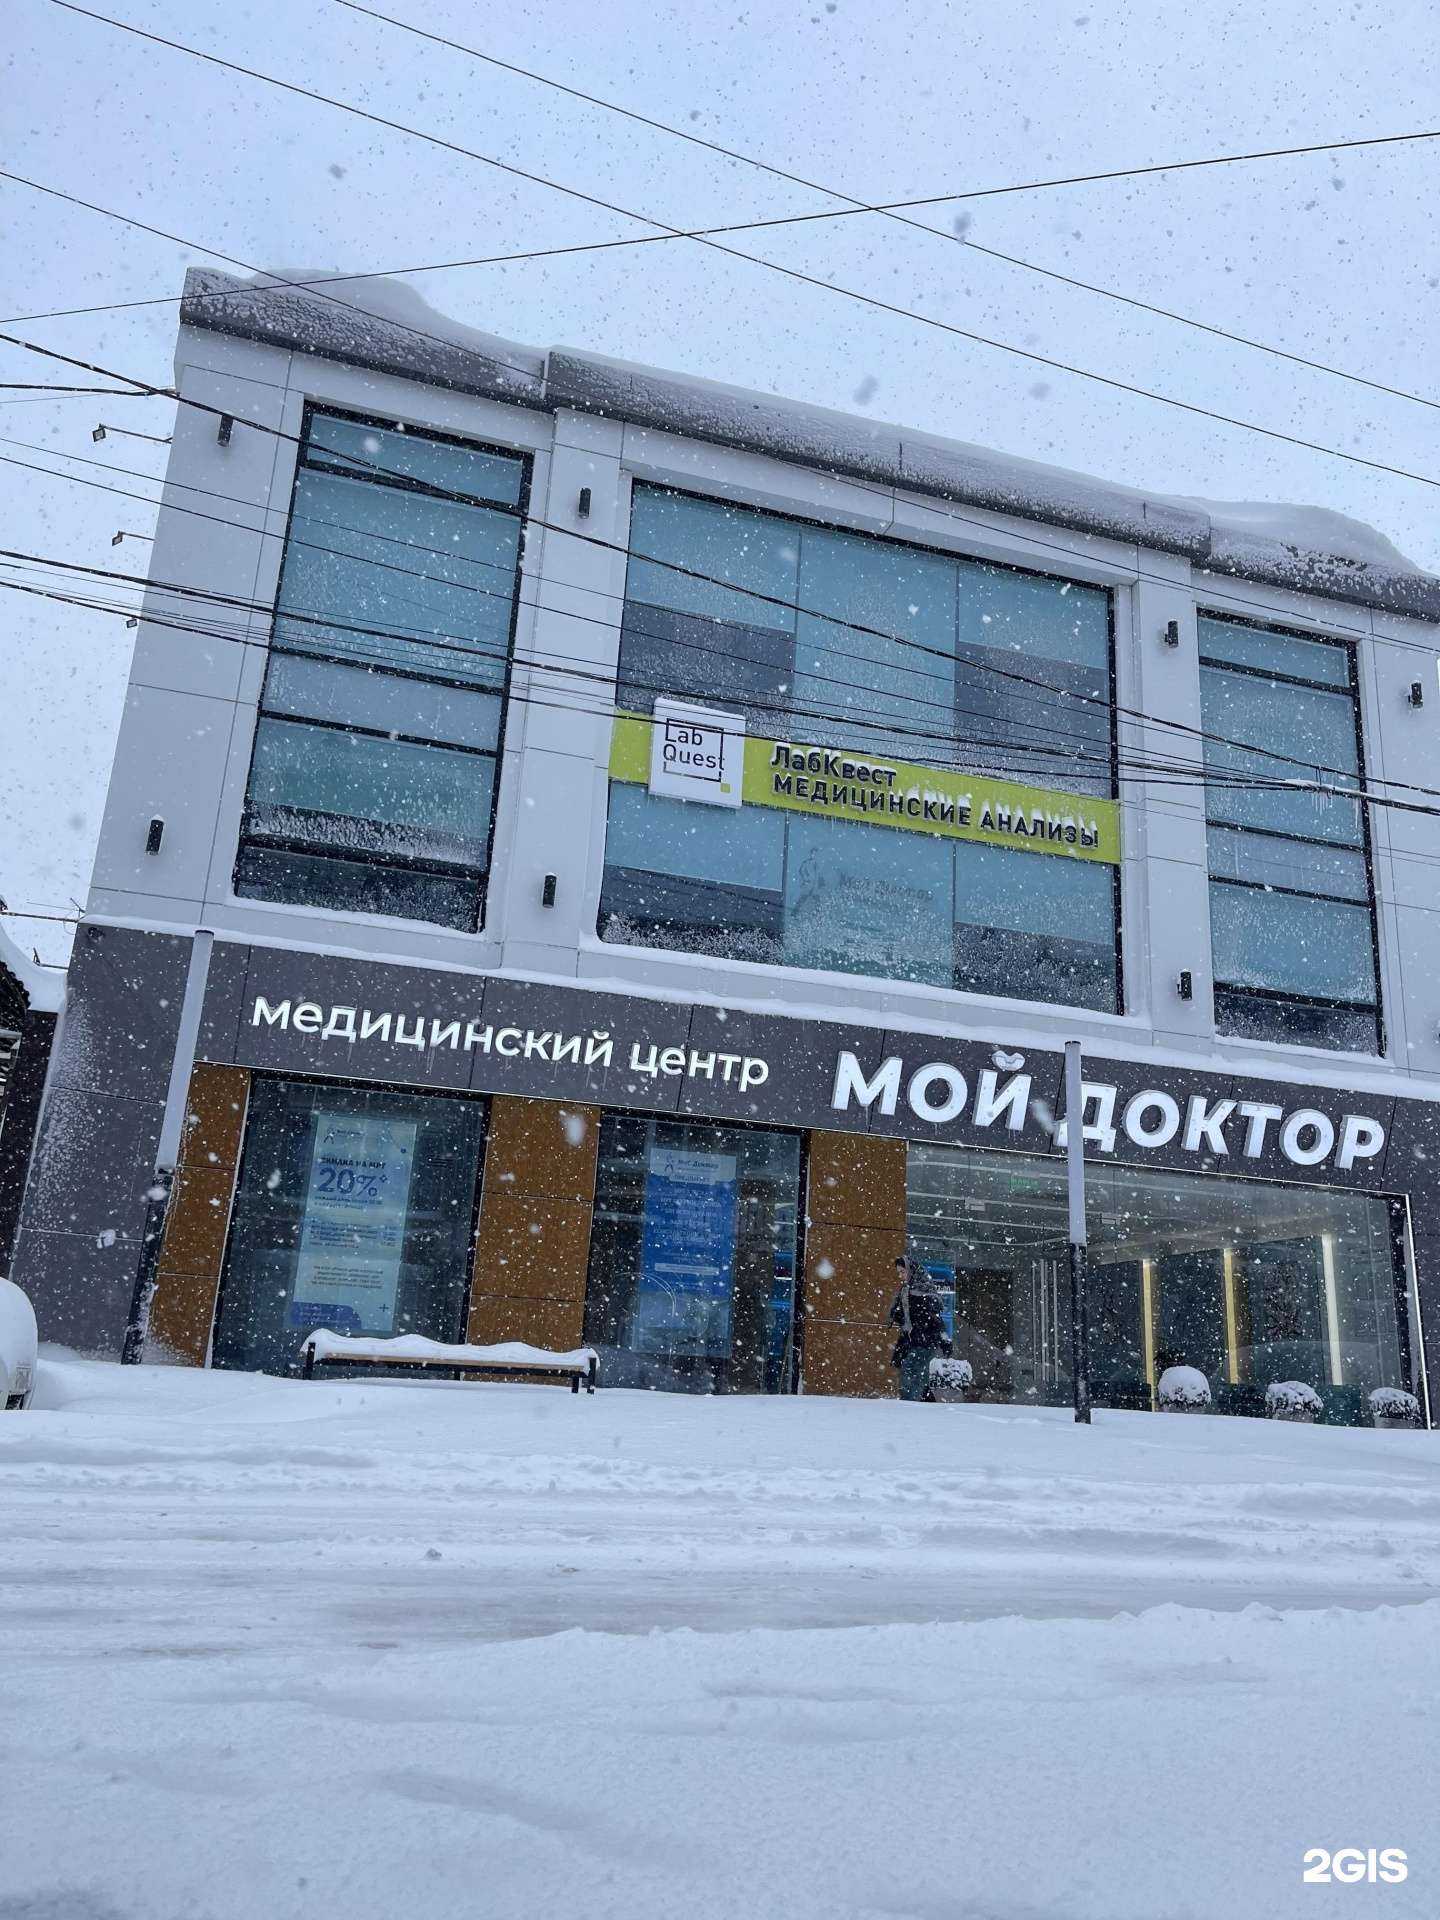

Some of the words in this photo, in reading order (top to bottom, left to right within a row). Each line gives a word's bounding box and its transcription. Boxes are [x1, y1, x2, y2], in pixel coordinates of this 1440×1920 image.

[663, 743, 725, 771] Quest
[665, 722, 703, 746] Lab
[771, 744, 897, 787] ЛабКвест
[774, 773, 972, 826] МЕДИЦИНСКИЕ
[980, 809, 1099, 848] АНАЛИЗЫ
[629, 1042, 769, 1092] центр
[830, 1050, 1032, 1132] МОЙ
[1053, 1080, 1385, 1170] ДОКТОР
